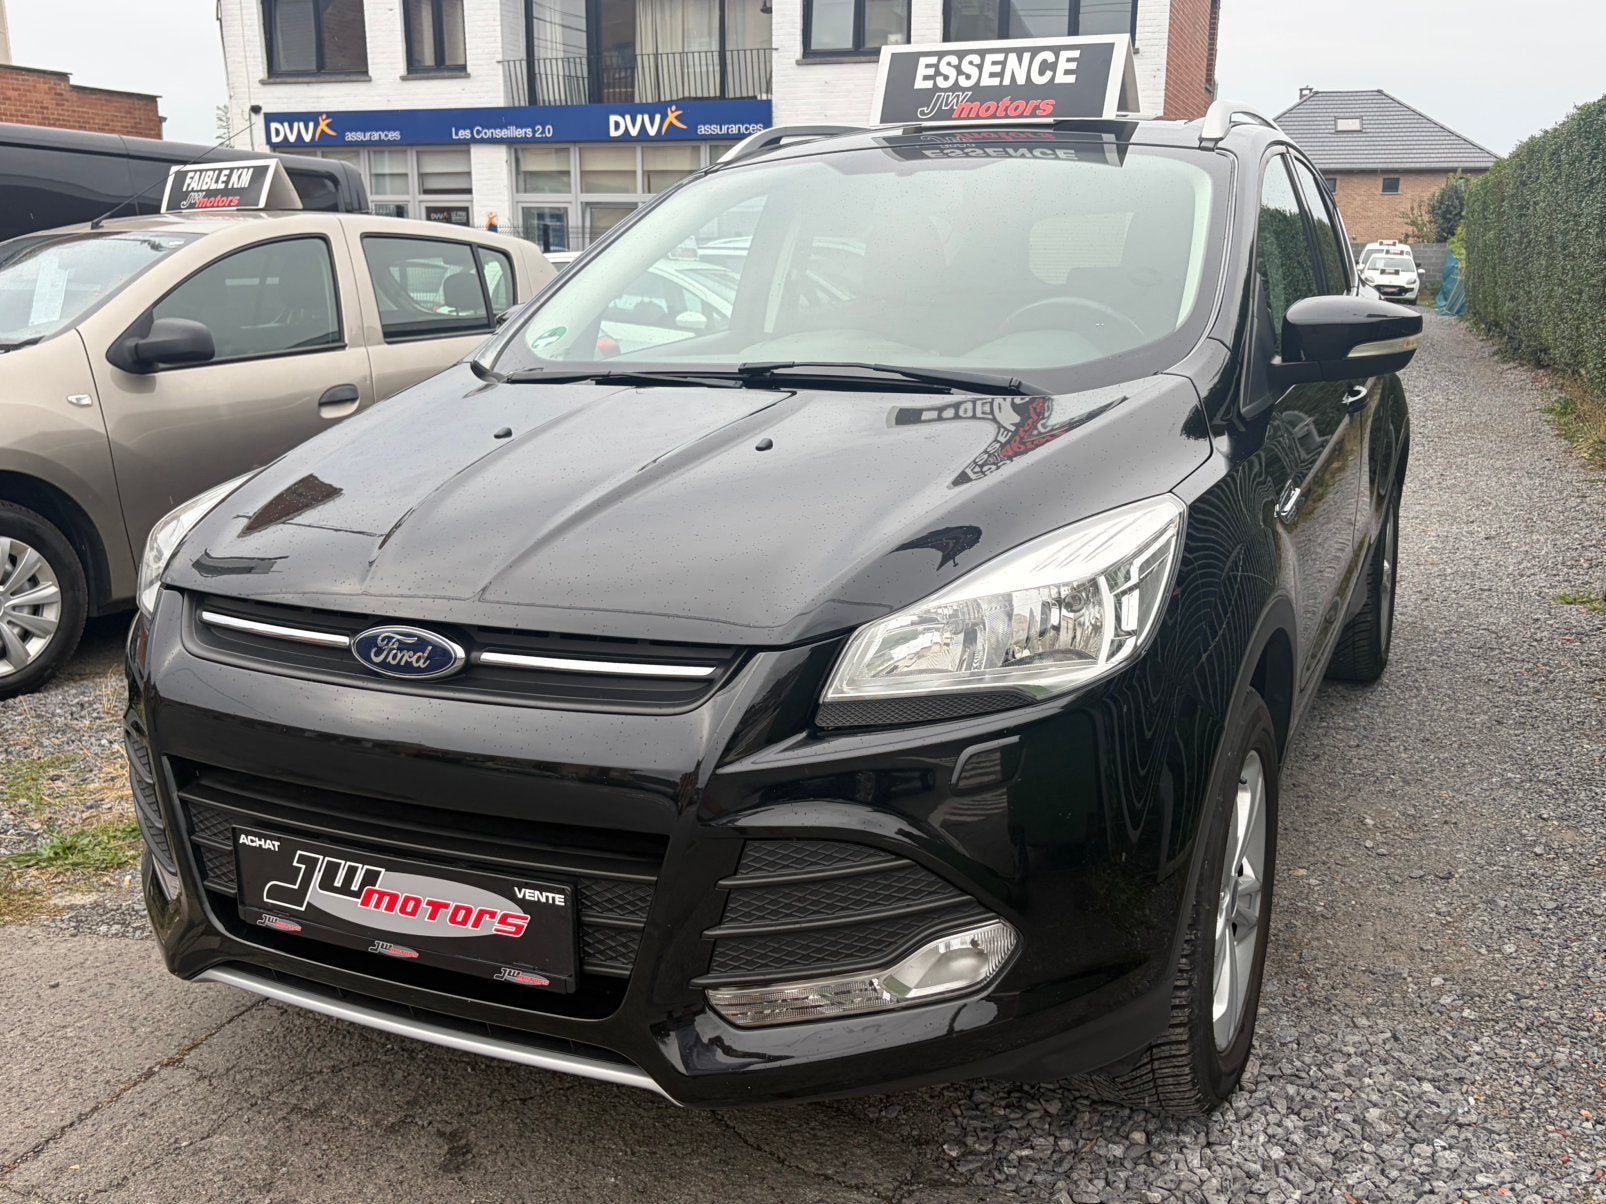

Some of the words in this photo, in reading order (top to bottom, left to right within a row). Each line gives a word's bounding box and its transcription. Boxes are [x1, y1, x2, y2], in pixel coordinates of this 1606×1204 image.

[914, 50, 1081, 90] ESSENCE
[917, 91, 972, 119] JW
[952, 96, 1056, 119] motors
[270, 121, 314, 143] DVV
[345, 130, 401, 141] assurances
[452, 126, 471, 139] Les
[473, 125, 533, 139] Conseillers
[535, 125, 553, 138] 2.0
[609, 114, 661, 137] DVV
[697, 122, 764, 135] assurances
[182, 169, 228, 191] FAIBLE
[228, 168, 253, 189] KM
[195, 194, 241, 208] motors
[370, 632, 433, 668] Ford
[239, 834, 281, 852] ACHAT
[263, 850, 386, 911] JW
[514, 886, 566, 907] VENTE
